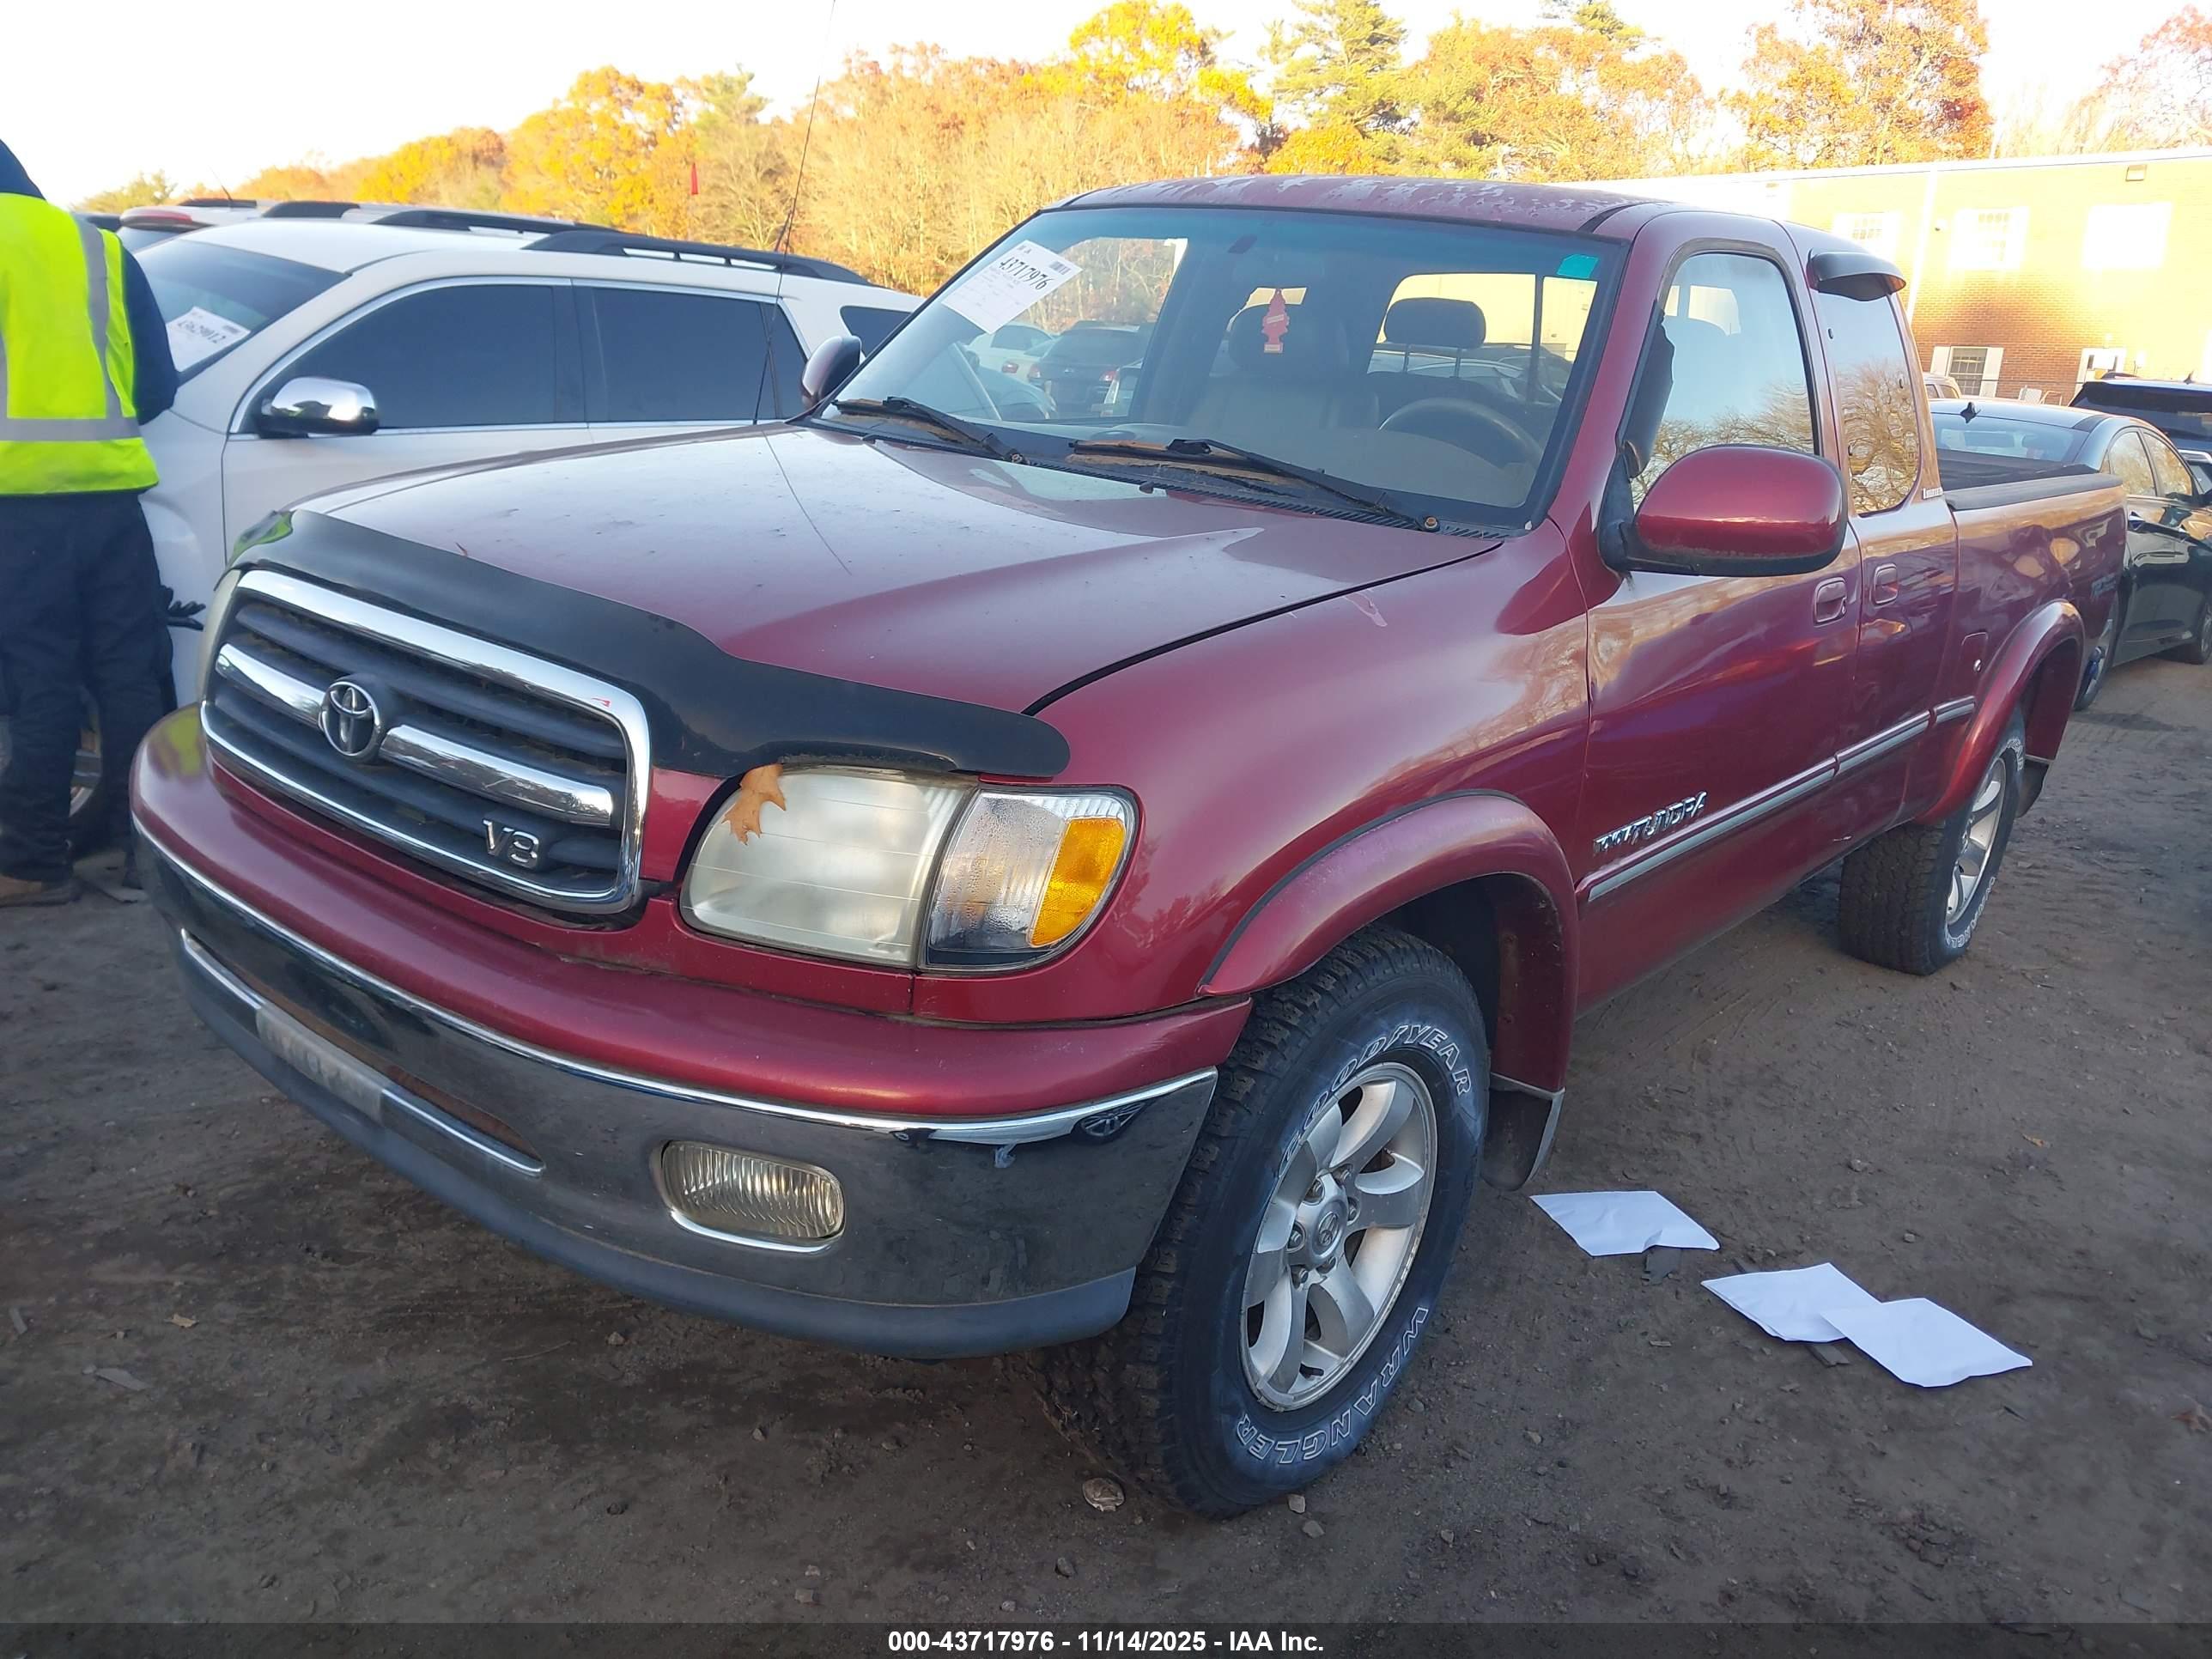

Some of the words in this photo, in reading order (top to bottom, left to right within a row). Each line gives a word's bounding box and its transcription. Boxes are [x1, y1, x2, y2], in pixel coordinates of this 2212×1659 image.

[999, 257, 1054, 290] 43717976
[482, 819, 540, 869] V8
[1277, 1024, 1474, 1179] GOODYEAR
[1235, 1305, 1431, 1466] WRANGLER
